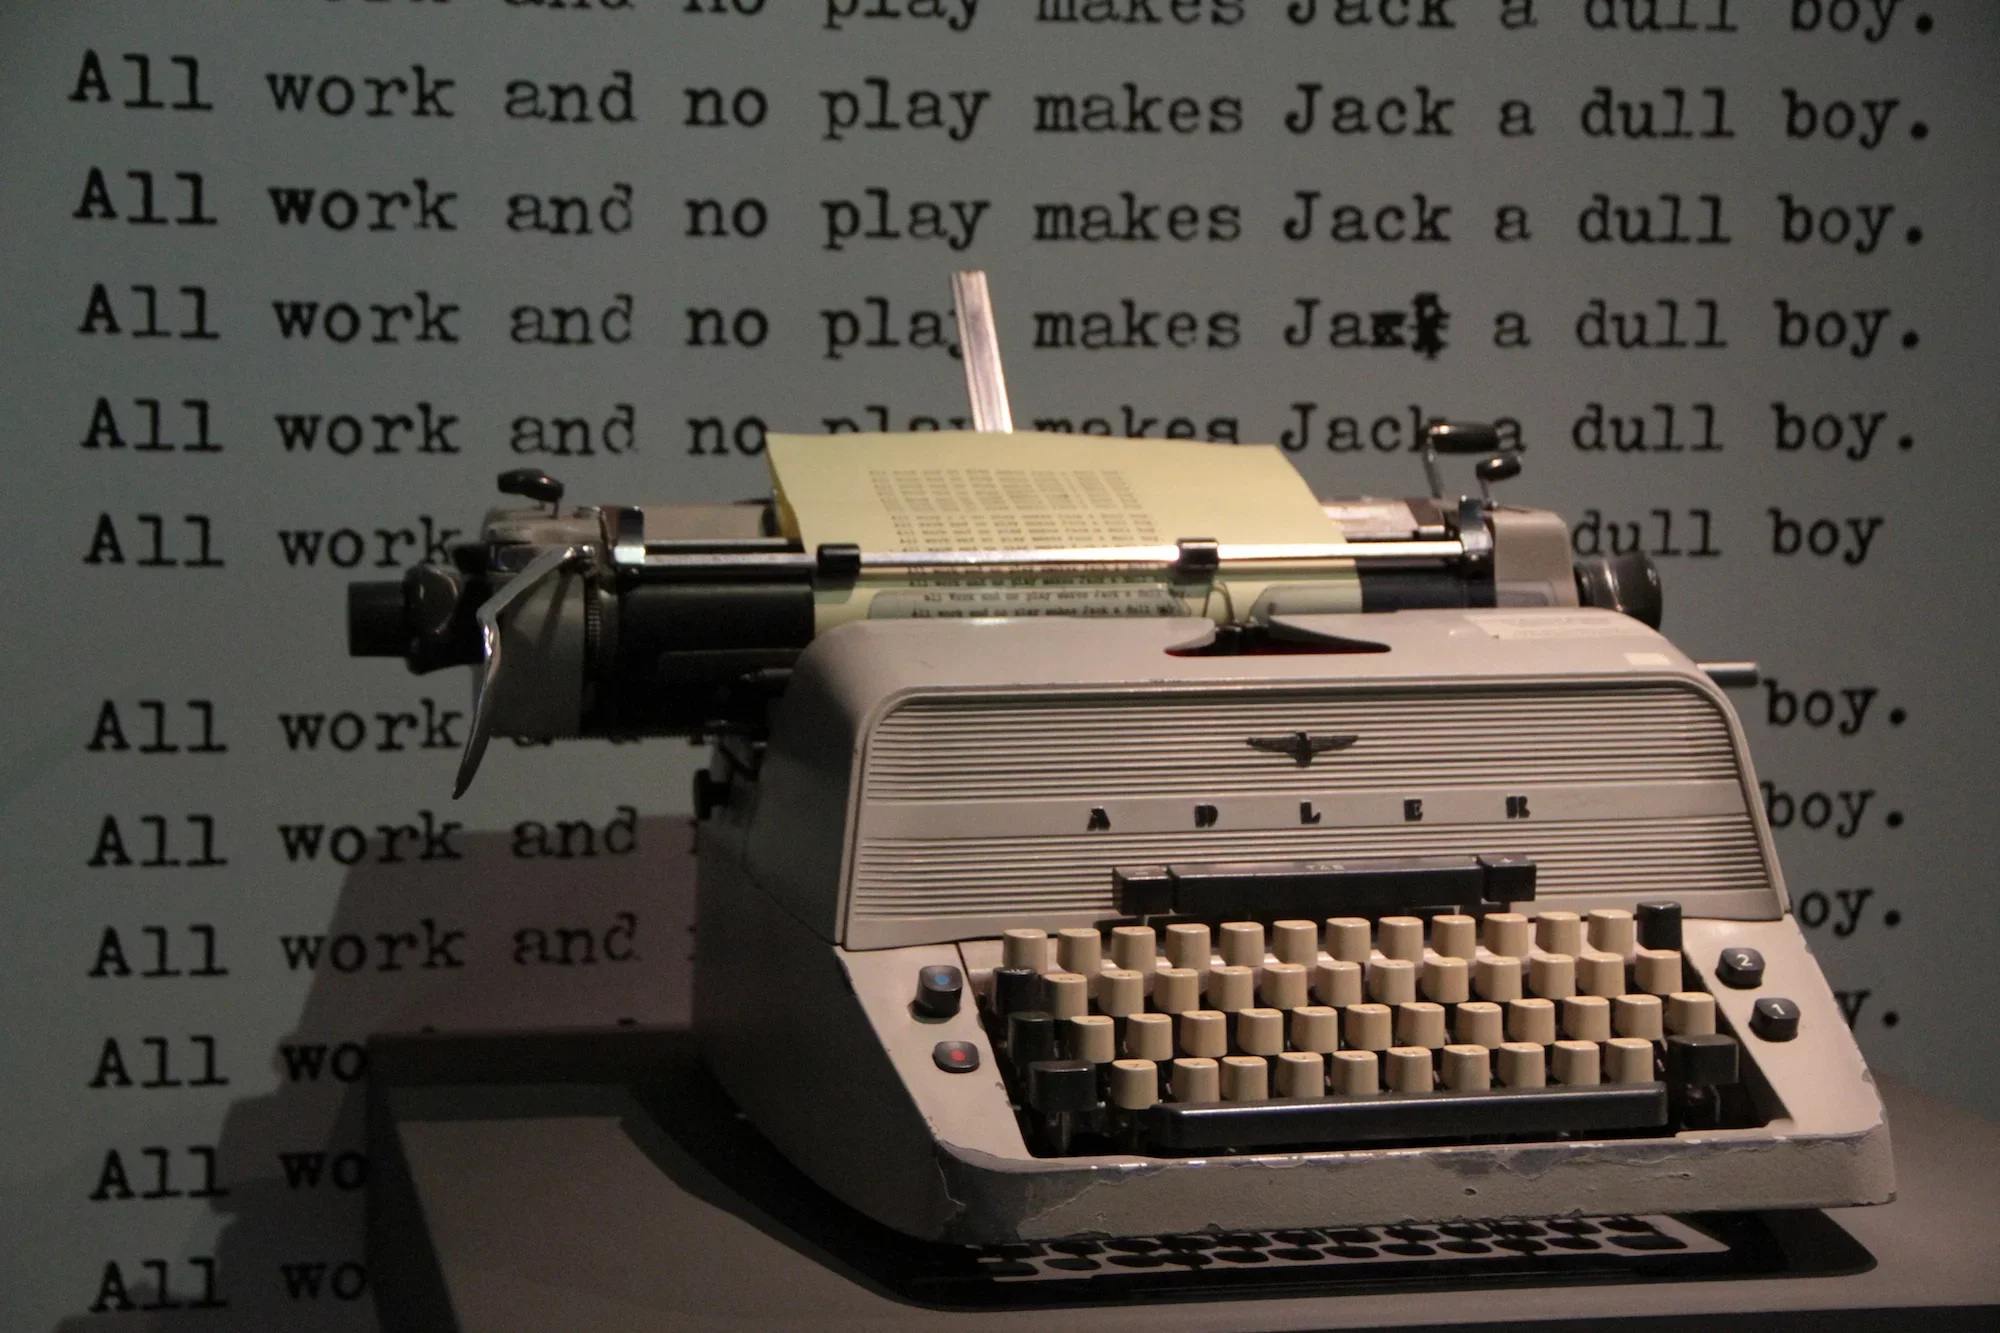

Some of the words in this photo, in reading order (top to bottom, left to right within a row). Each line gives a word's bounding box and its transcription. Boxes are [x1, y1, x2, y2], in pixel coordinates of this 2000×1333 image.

[1499, 0, 1537, 30] a
[1791, 0, 1934, 44] boy.
[68, 49, 213, 112] All
[265, 64, 455, 118] work
[504, 70, 636, 123] and
[683, 87, 769, 128] no
[819, 76, 991, 142] play
[1034, 82, 1243, 134] makes
[1284, 83, 1455, 137] Jack
[1498, 100, 1536, 137] a
[1580, 86, 1735, 140] dull
[1781, 88, 1929, 150] boy.
[72, 166, 218, 226] All
[267, 178, 457, 232] work
[506, 182, 633, 236] and
[685, 198, 768, 238] no
[821, 187, 991, 252] play
[1034, 191, 1241, 242] makes
[1283, 190, 1451, 243] Jack
[1495, 205, 1532, 242] a
[1578, 193, 1731, 245] dull
[1776, 193, 1923, 255] boy.
[77, 283, 220, 341] All
[272, 290, 460, 344] work
[510, 293, 633, 346] and
[685, 308, 769, 348] no
[1033, 299, 1240, 350] makes
[1493, 311, 1531, 348] a
[1575, 299, 1727, 350] dull
[1773, 299, 1920, 359] boy.
[80, 396, 223, 453] All
[274, 401, 460, 456] work
[510, 403, 637, 456] and
[687, 416, 769, 457] no
[1494, 416, 1526, 452] a
[1571, 402, 1723, 453] dull
[1770, 401, 1914, 462] boy.
[83, 512, 225, 568] All
[277, 516, 462, 569] work
[1571, 509, 1722, 557] dull
[1767, 507, 1884, 567] boy
[85, 699, 228, 755] All
[278, 698, 464, 752] work
[1763, 678, 1907, 736] boy.
[87, 814, 228, 868] All
[278, 810, 463, 866] work
[511, 805, 638, 860] and
[1761, 781, 1904, 839] boy.
[1087, 795, 1530, 831] ADLER
[87, 924, 229, 978] All
[280, 917, 466, 974] work
[512, 911, 639, 966] and
[1798, 888, 1900, 938] oy.
[1735, 953, 1753, 967] 2
[1771, 1003, 1785, 1016] 1
[87, 1035, 230, 1089] All
[88, 1145, 231, 1202] All
[89, 1256, 231, 1314] All
